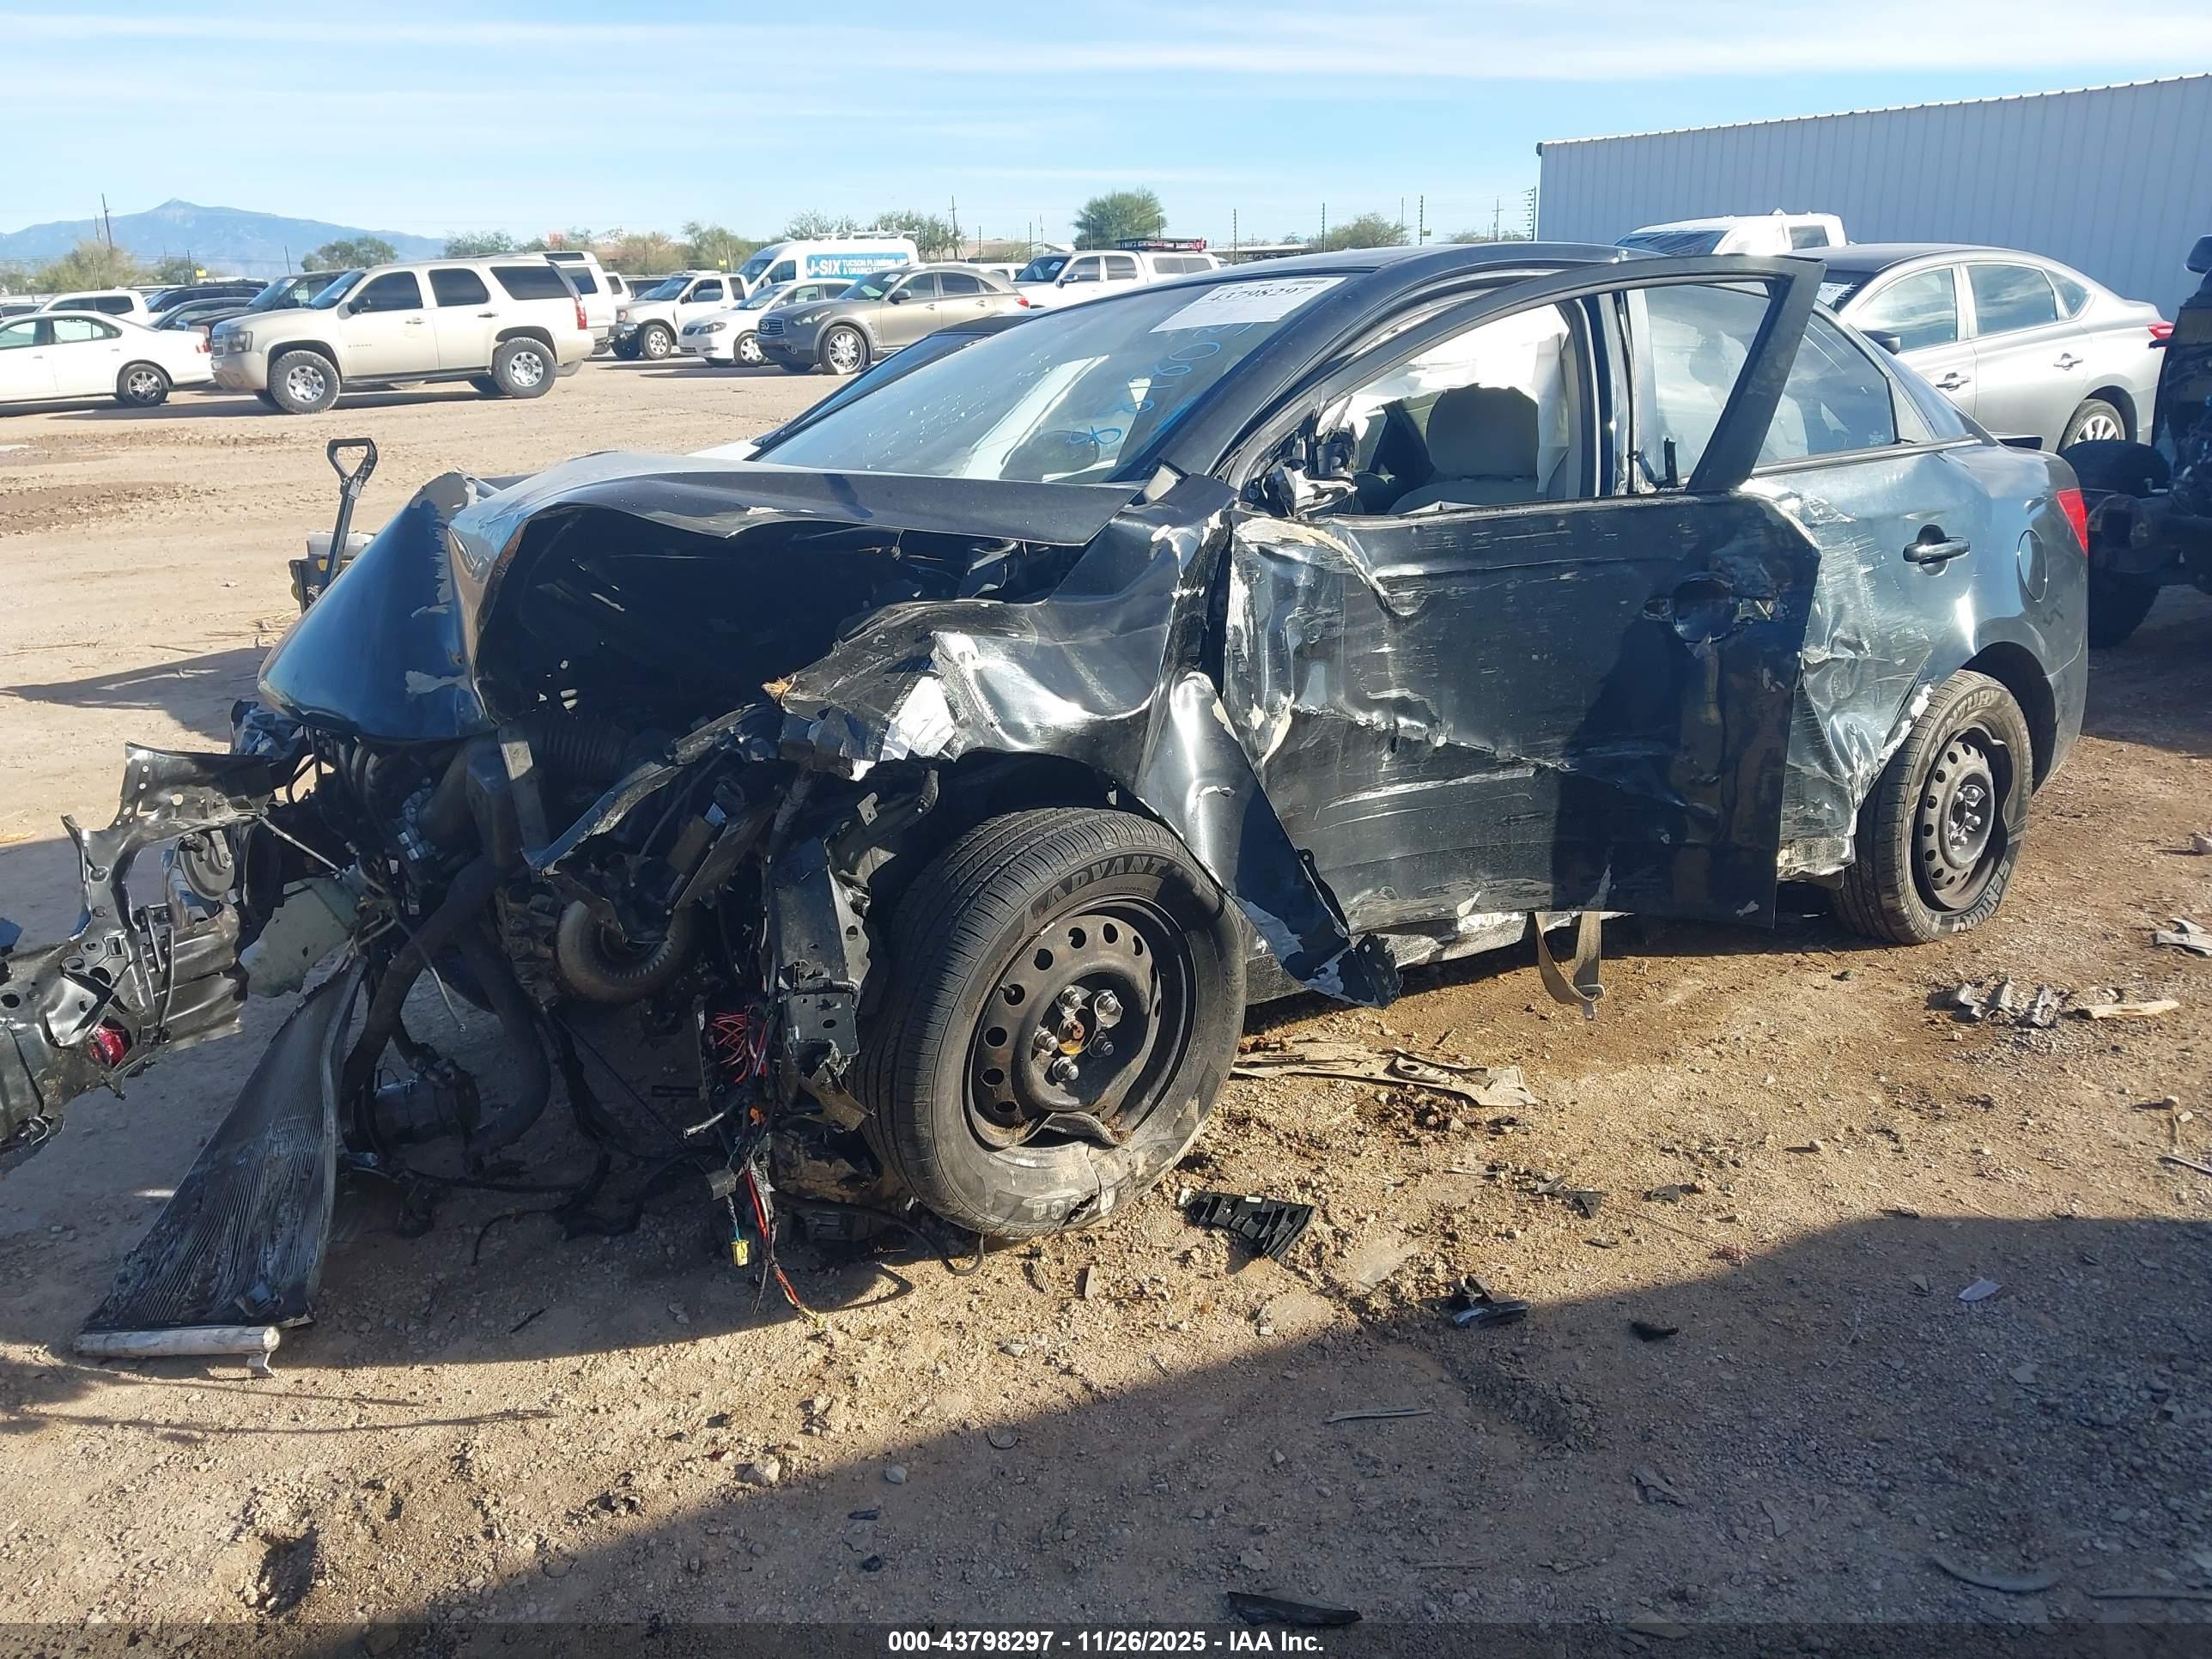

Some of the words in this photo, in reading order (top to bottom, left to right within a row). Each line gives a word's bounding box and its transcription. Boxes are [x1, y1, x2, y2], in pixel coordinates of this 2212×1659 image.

[807, 259, 842, 276] J-SIX
[1207, 286, 1314, 302] 43798297
[1951, 860, 2011, 933] SENTURY
